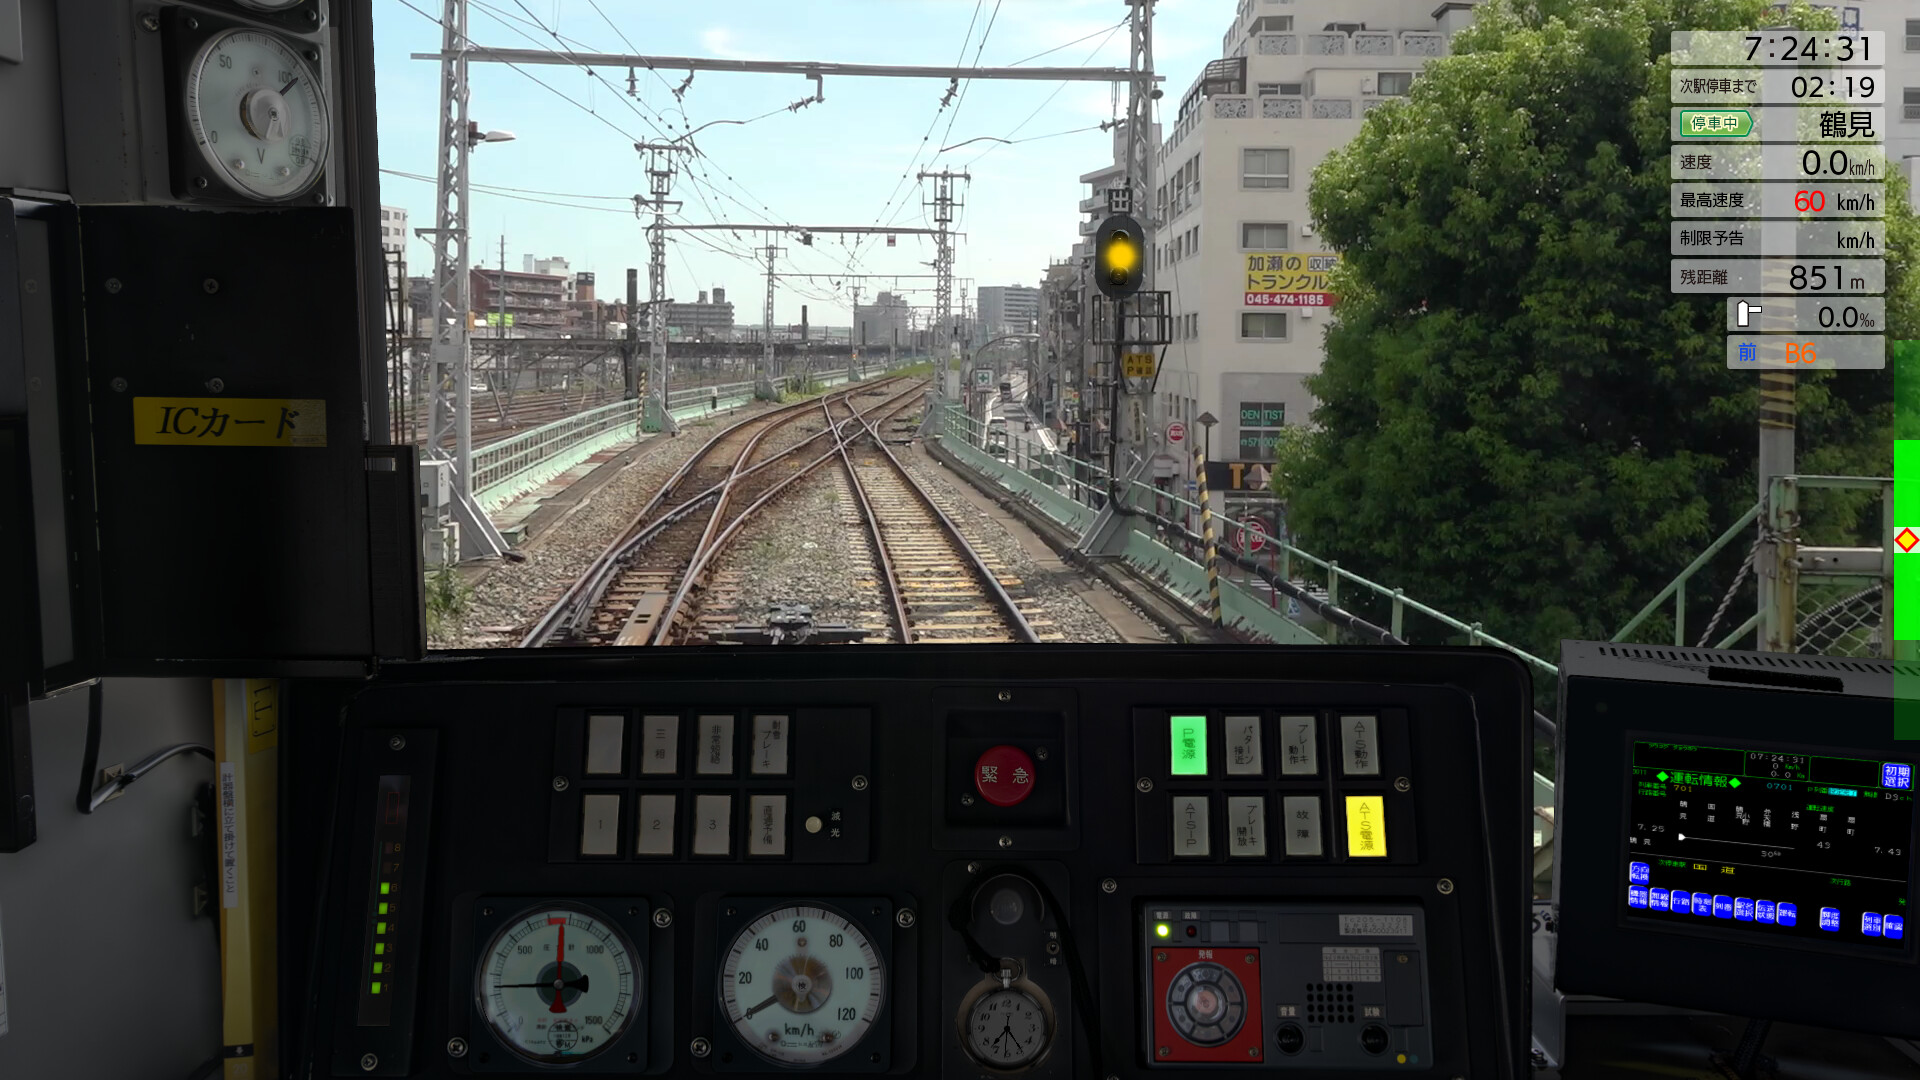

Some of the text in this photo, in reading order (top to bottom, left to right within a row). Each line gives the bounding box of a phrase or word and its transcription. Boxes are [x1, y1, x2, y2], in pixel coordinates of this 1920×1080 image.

[219, 54, 232, 69] 50
[211, 130, 218, 144] 0
[257, 148, 265, 164] V
[1127, 355, 1153, 364] ATS
[156, 406, 300, 439] ICカード
[1354, 721, 1368, 769] ATS動作
[1234, 746, 1244, 765] 接近
[1288, 745, 1299, 765] 動作
[1750, 752, 1805, 765] 07:24:31
[982, 766, 1029, 784] 緊急
[1669, 771, 1728, 789] 運転情報
[1673, 784, 1693, 793] 701
[1766, 782, 1793, 791] 0701
[652, 819, 661, 830] 2
[708, 819, 716, 830] 3
[1296, 810, 1309, 839] 故障
[1359, 802, 1374, 851] ATS電源
[1236, 827, 1247, 847] 開放
[792, 920, 806, 933] 60
[755, 938, 769, 951] 40
[829, 934, 843, 948] 80
[517, 945, 533, 955] 500
[586, 945, 604, 954] 1000
[738, 971, 752, 984] 20
[845, 967, 864, 980] 100
[584, 1015, 603, 1025] 1500
[837, 1007, 856, 1021] 120
[784, 1023, 814, 1037] km/h
[581, 1035, 593, 1044] kPa
